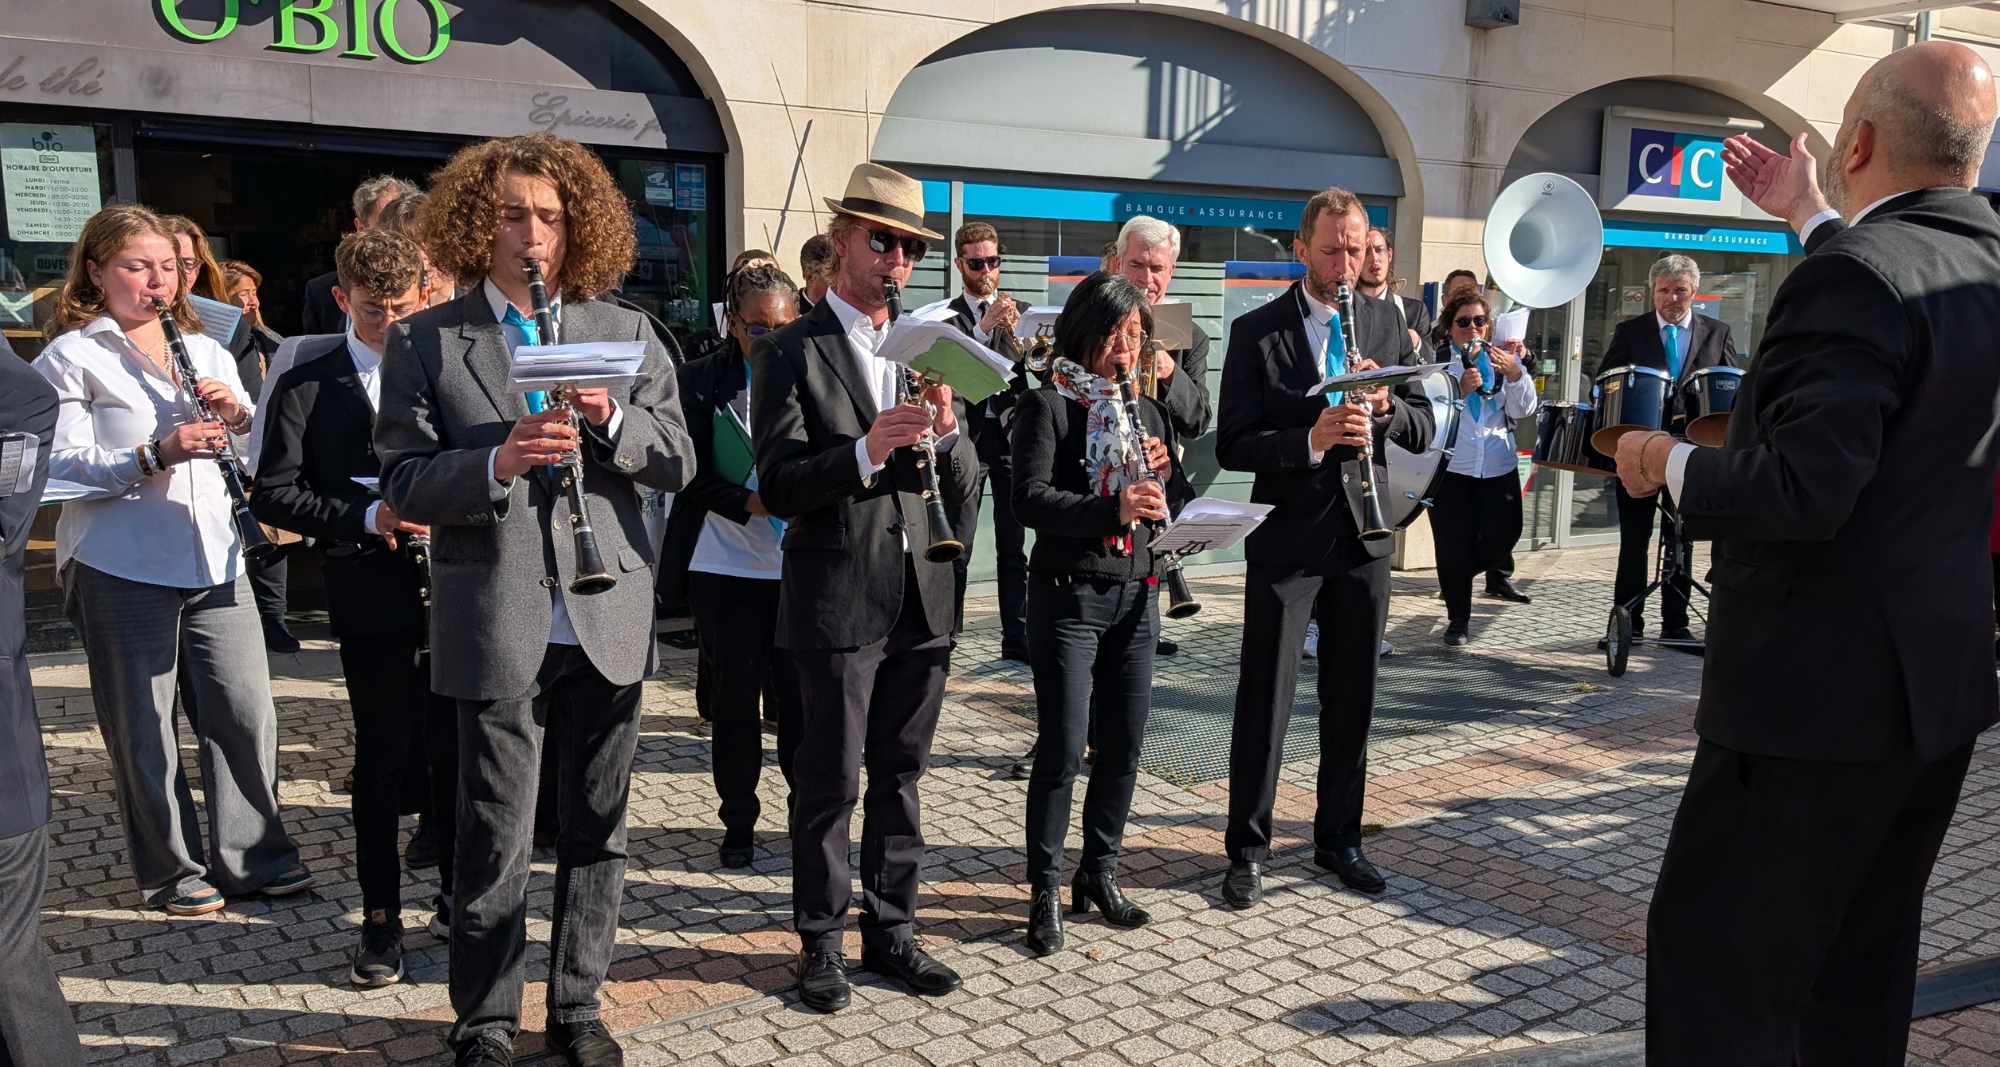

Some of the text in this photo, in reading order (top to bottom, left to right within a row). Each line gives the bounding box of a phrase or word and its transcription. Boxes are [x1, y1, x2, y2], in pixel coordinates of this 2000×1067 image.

[39, 56, 105, 96] thé
[529, 92, 638, 131] Epicerie
[32, 132, 63, 152] bio
[6, 164, 93, 173] HORAIRE D'OUVERTURE
[1638, 143, 1716, 188] CIC
[1126, 203, 1283, 220] BANQUE ASSURANCE
[1664, 232, 1768, 245] BANQUE ASSURANCE
